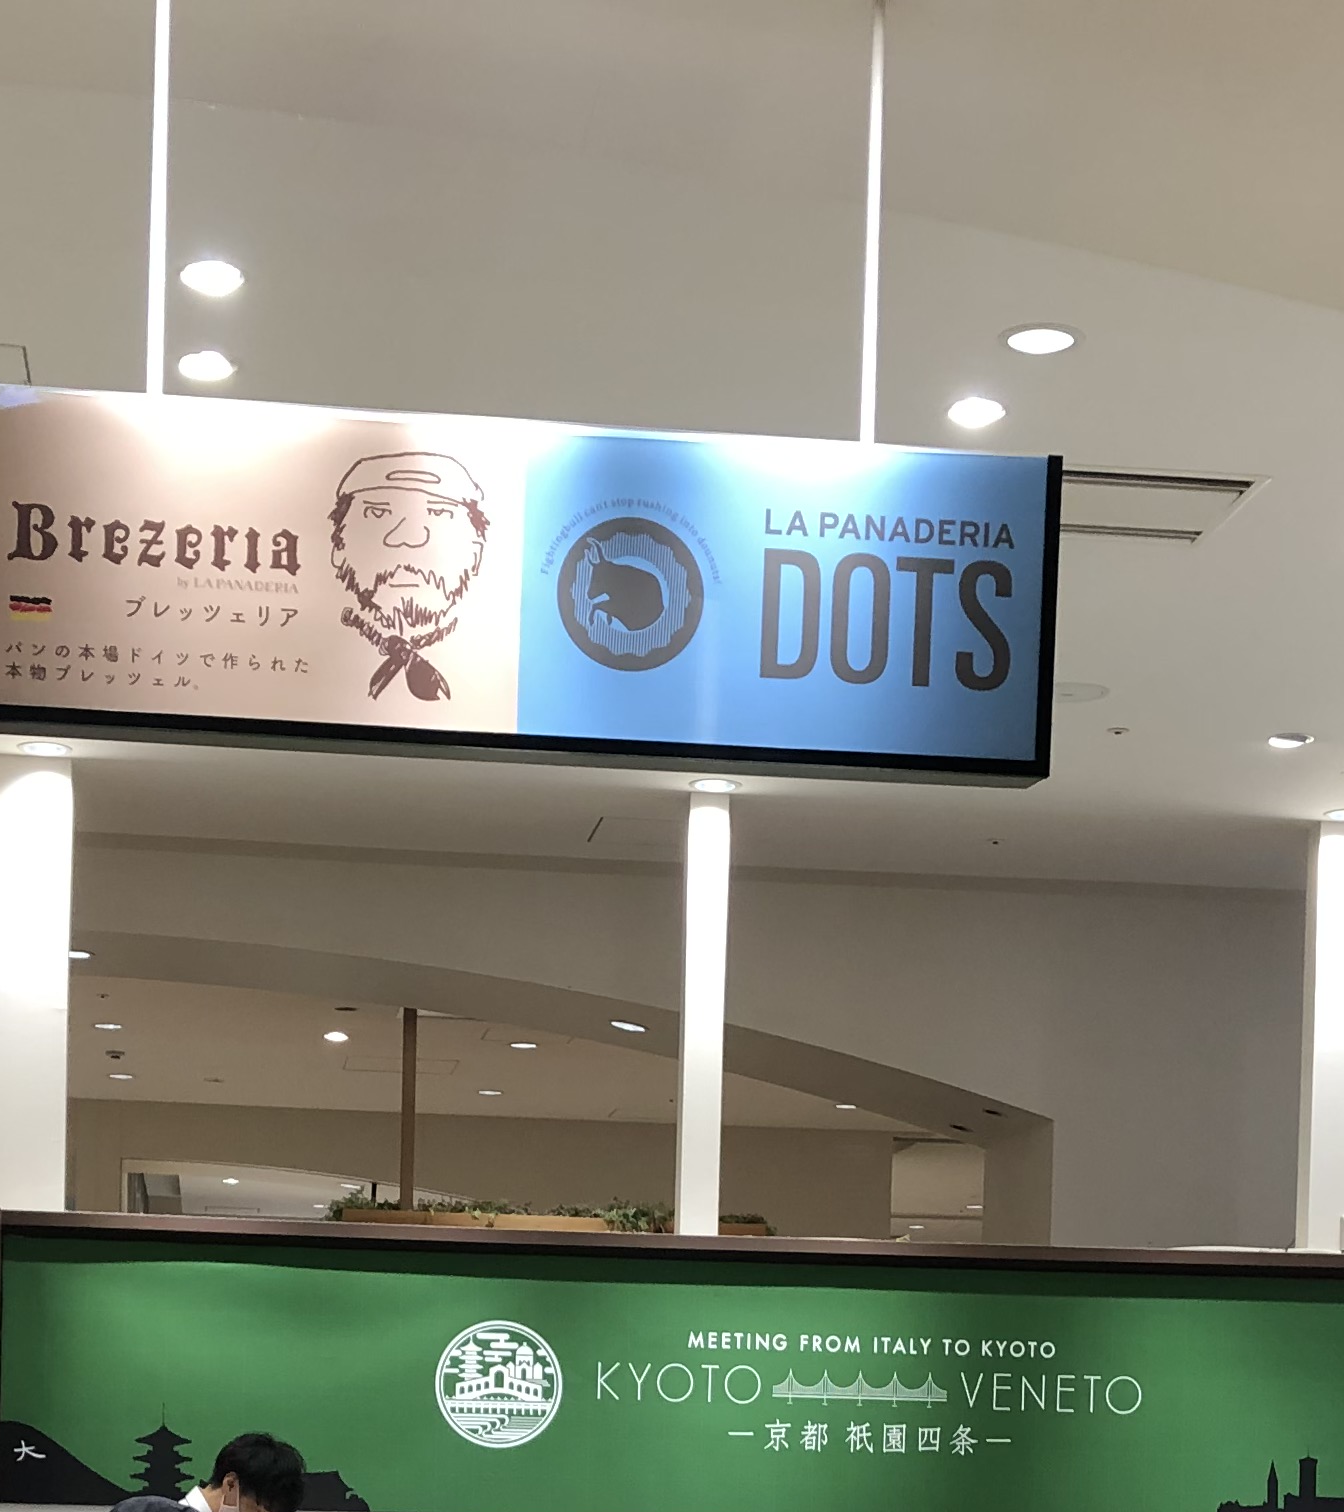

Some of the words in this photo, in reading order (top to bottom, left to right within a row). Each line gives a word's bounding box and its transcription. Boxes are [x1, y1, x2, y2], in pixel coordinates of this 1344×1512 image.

[611, 498, 636, 507] stop
[680, 516, 698, 536] into
[764, 508, 808, 537] LA
[819, 511, 1015, 549] PANADERIA
[7, 501, 301, 576] Brezeria
[194, 577, 214, 589] LA
[216, 579, 298, 594] PANADERIA
[126, 596, 298, 627] ブレッツェリア
[759, 548, 1013, 691] DOTS
[6, 642, 309, 673] パンの本場ドイツで作られた
[688, 1331, 788, 1352] MEETING
[799, 1334, 862, 1354] FROM
[873, 1337, 932, 1356] ITALY
[942, 1339, 970, 1358] TO
[980, 1340, 1056, 1359] KYOTO
[597, 1361, 761, 1404] KYOTO
[960, 1372, 1142, 1415] VENETO
[763, 1420, 829, 1453] 京都
